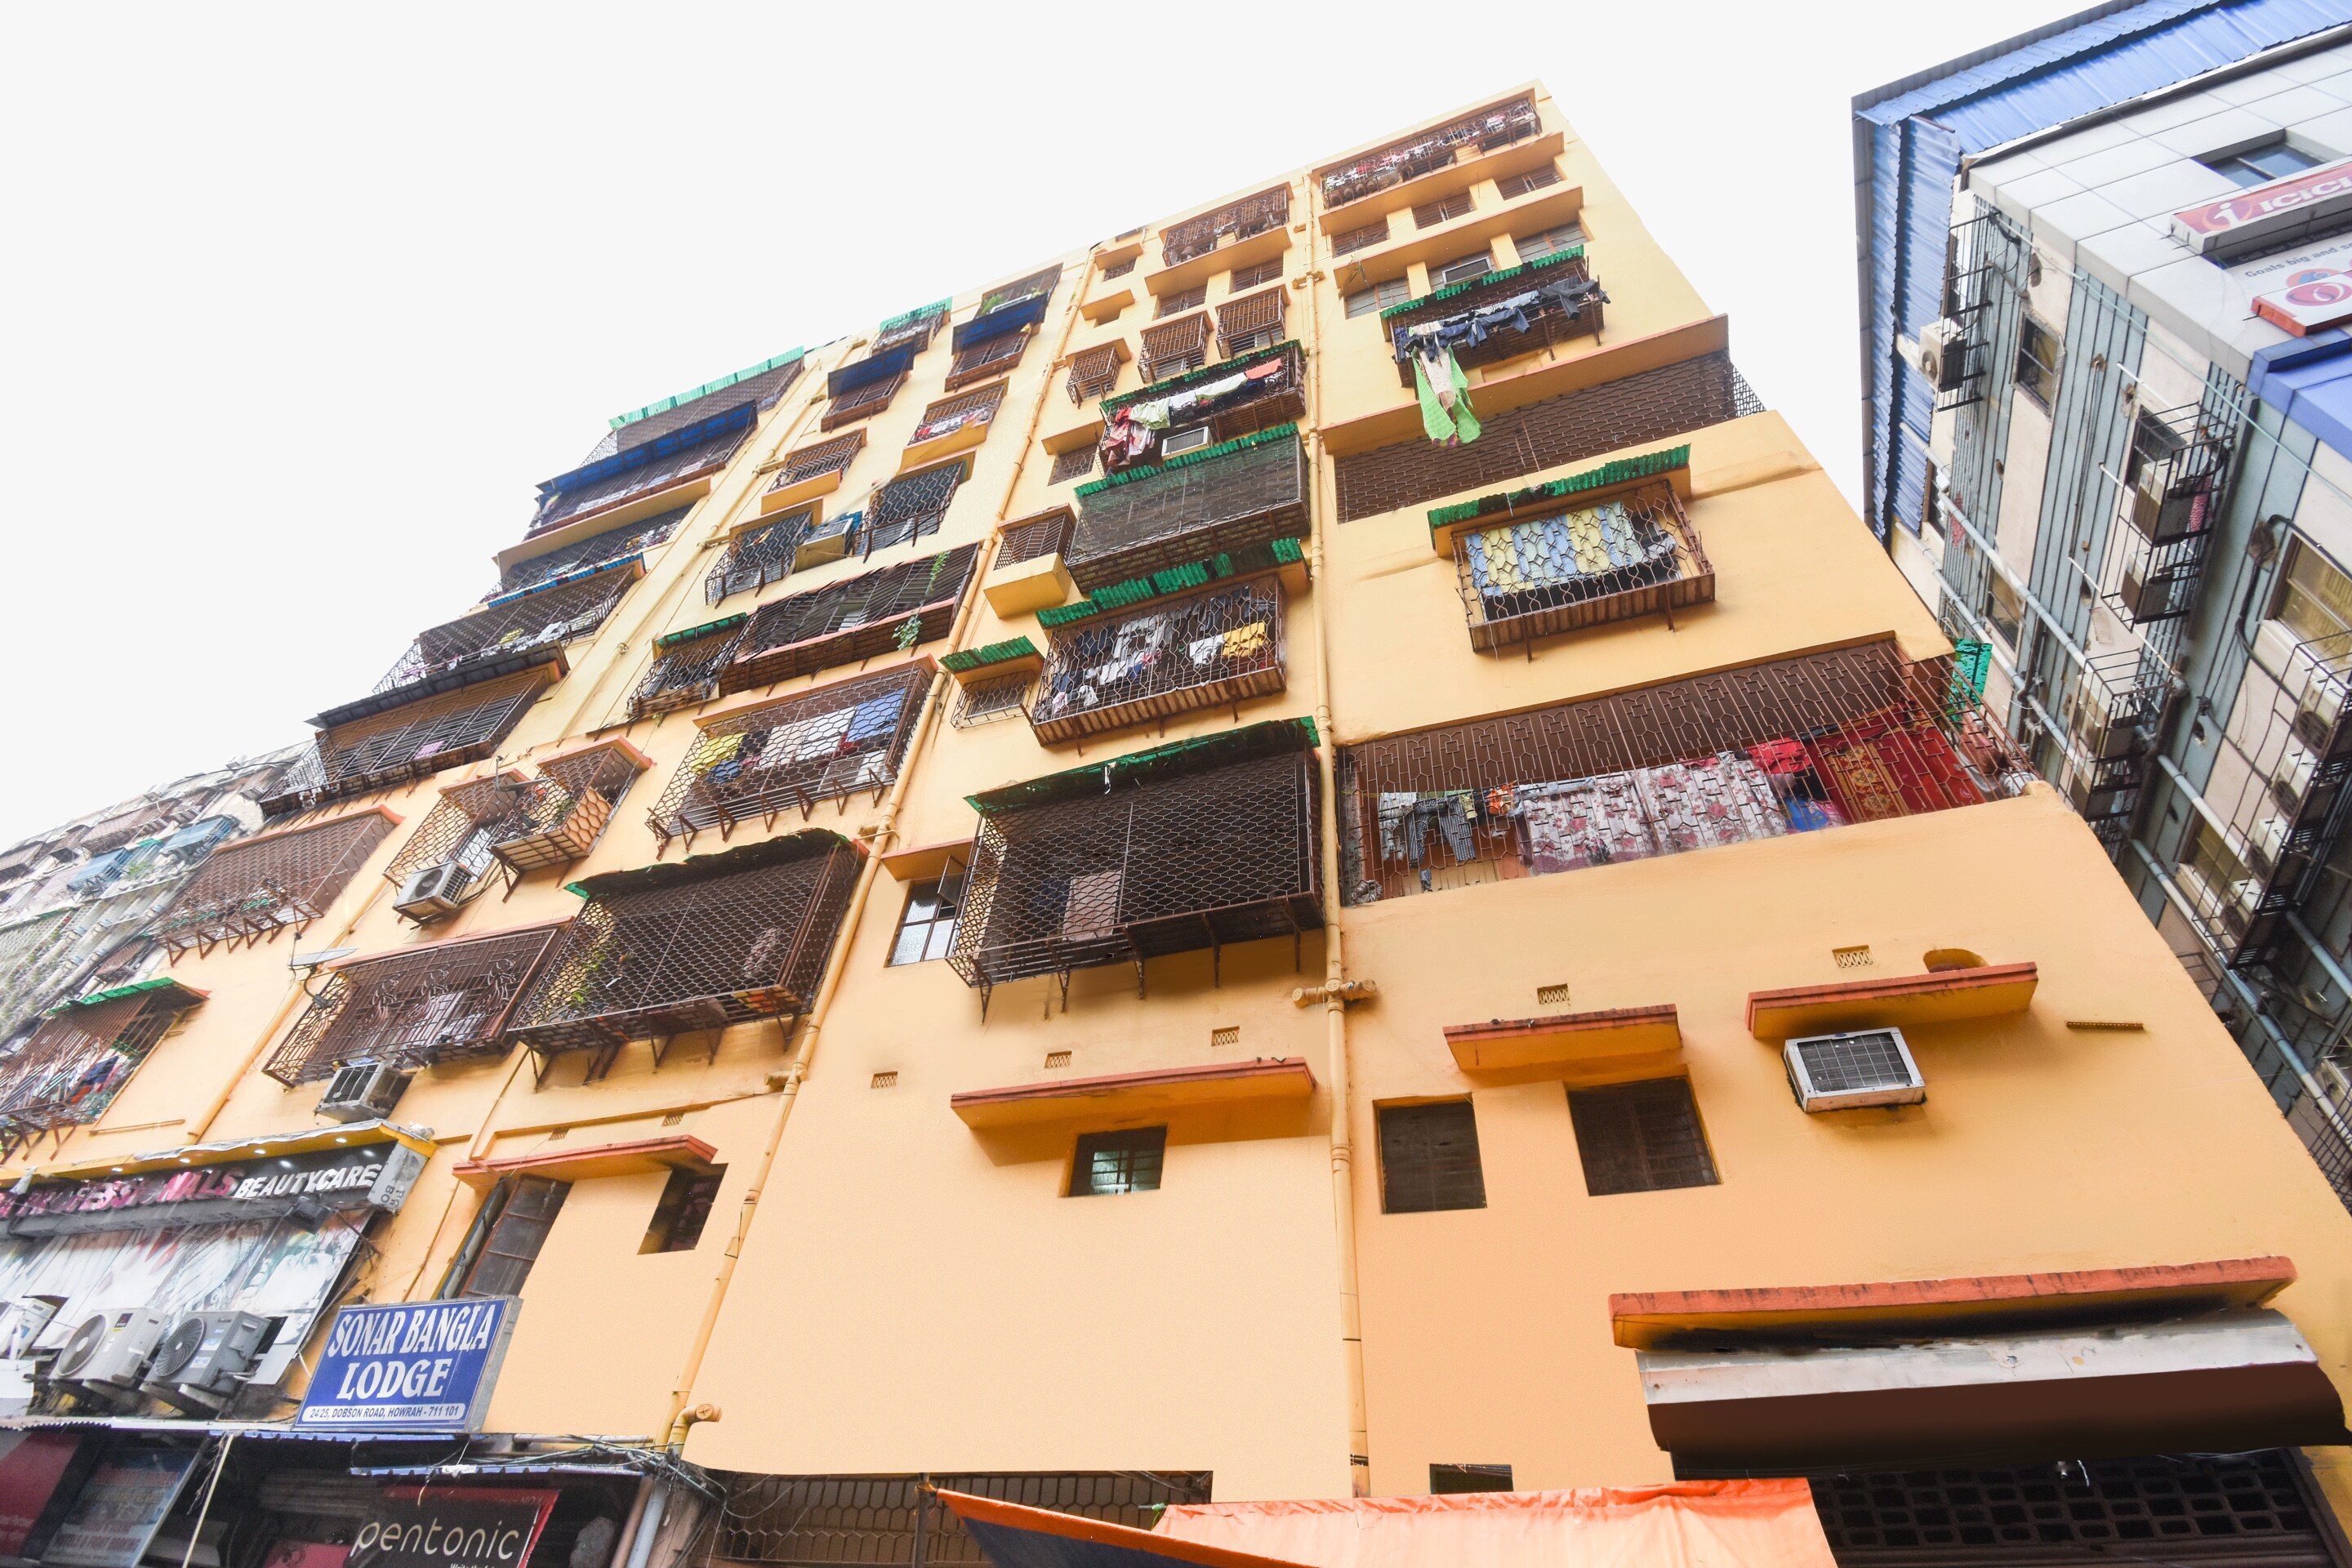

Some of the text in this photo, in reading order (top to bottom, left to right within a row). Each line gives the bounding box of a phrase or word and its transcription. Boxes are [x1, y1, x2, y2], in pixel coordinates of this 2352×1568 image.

[2260, 177, 2352, 212] ICICI
[2244, 262, 2285, 278] Goals
[2286, 255, 2310, 266] big
[2312, 247, 2338, 259] and
[327, 1304, 496, 1358] SONAR BANGLA
[336, 1358, 452, 1401] LODGE
[332, 1407, 363, 1418] DOBSON
[363, 1407, 385, 1419] ROAD,
[387, 1406, 423, 1418] HOWRAH
[428, 1406, 443, 1417] 711
[444, 1405, 460, 1416] 101
[350, 1517, 519, 1560] pentonic
